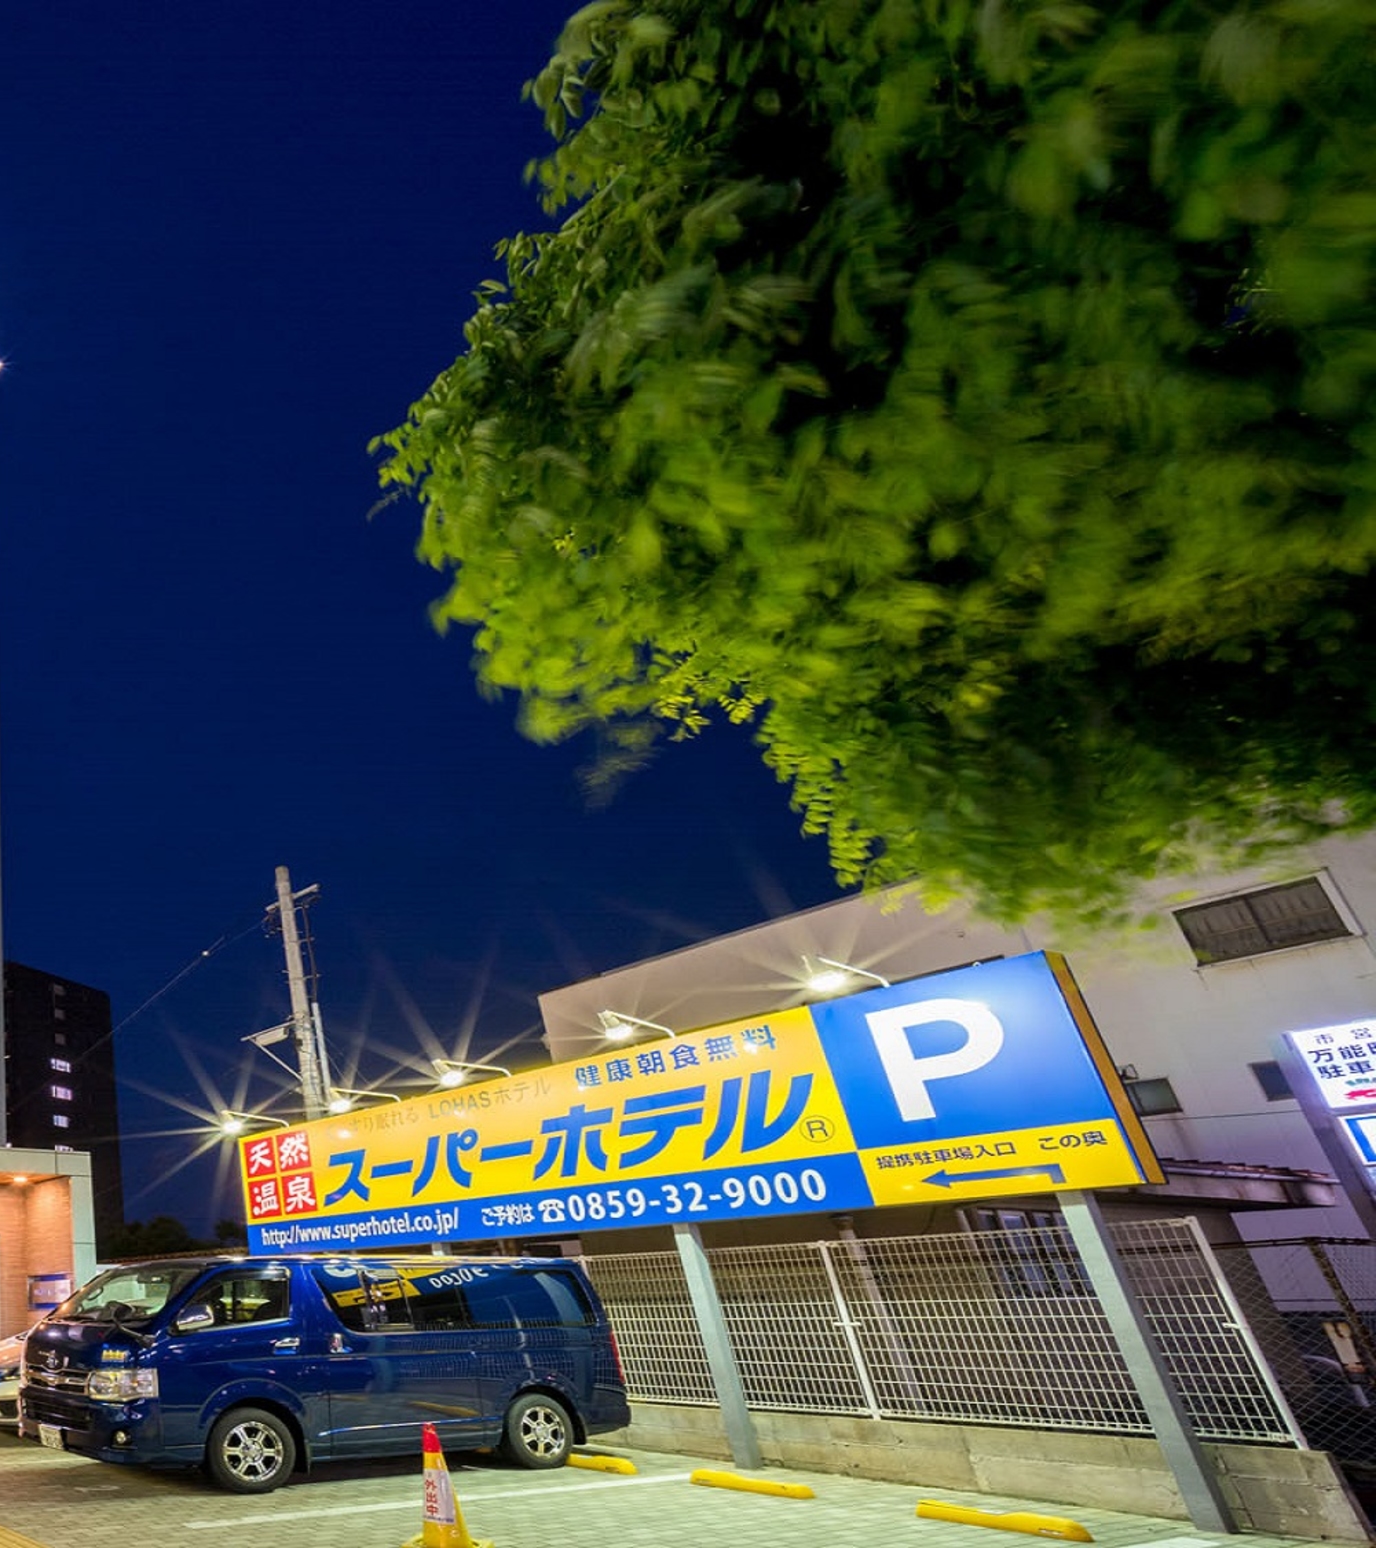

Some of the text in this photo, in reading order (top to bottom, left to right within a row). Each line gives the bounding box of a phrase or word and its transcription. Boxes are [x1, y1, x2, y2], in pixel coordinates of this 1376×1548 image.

[575, 1025, 776, 1087] 健康朝食無料
[865, 998, 1004, 1122] P
[249, 1133, 309, 1174] 天然
[324, 1069, 814, 1207] スーパーホテル
[876, 1131, 1108, 1169] 提携駐車場入口 この奥
[252, 1176, 315, 1215] 温泉
[261, 1169, 827, 1248] http://www.superhotel.co.jp/ ご予約は 0859-32-9000
